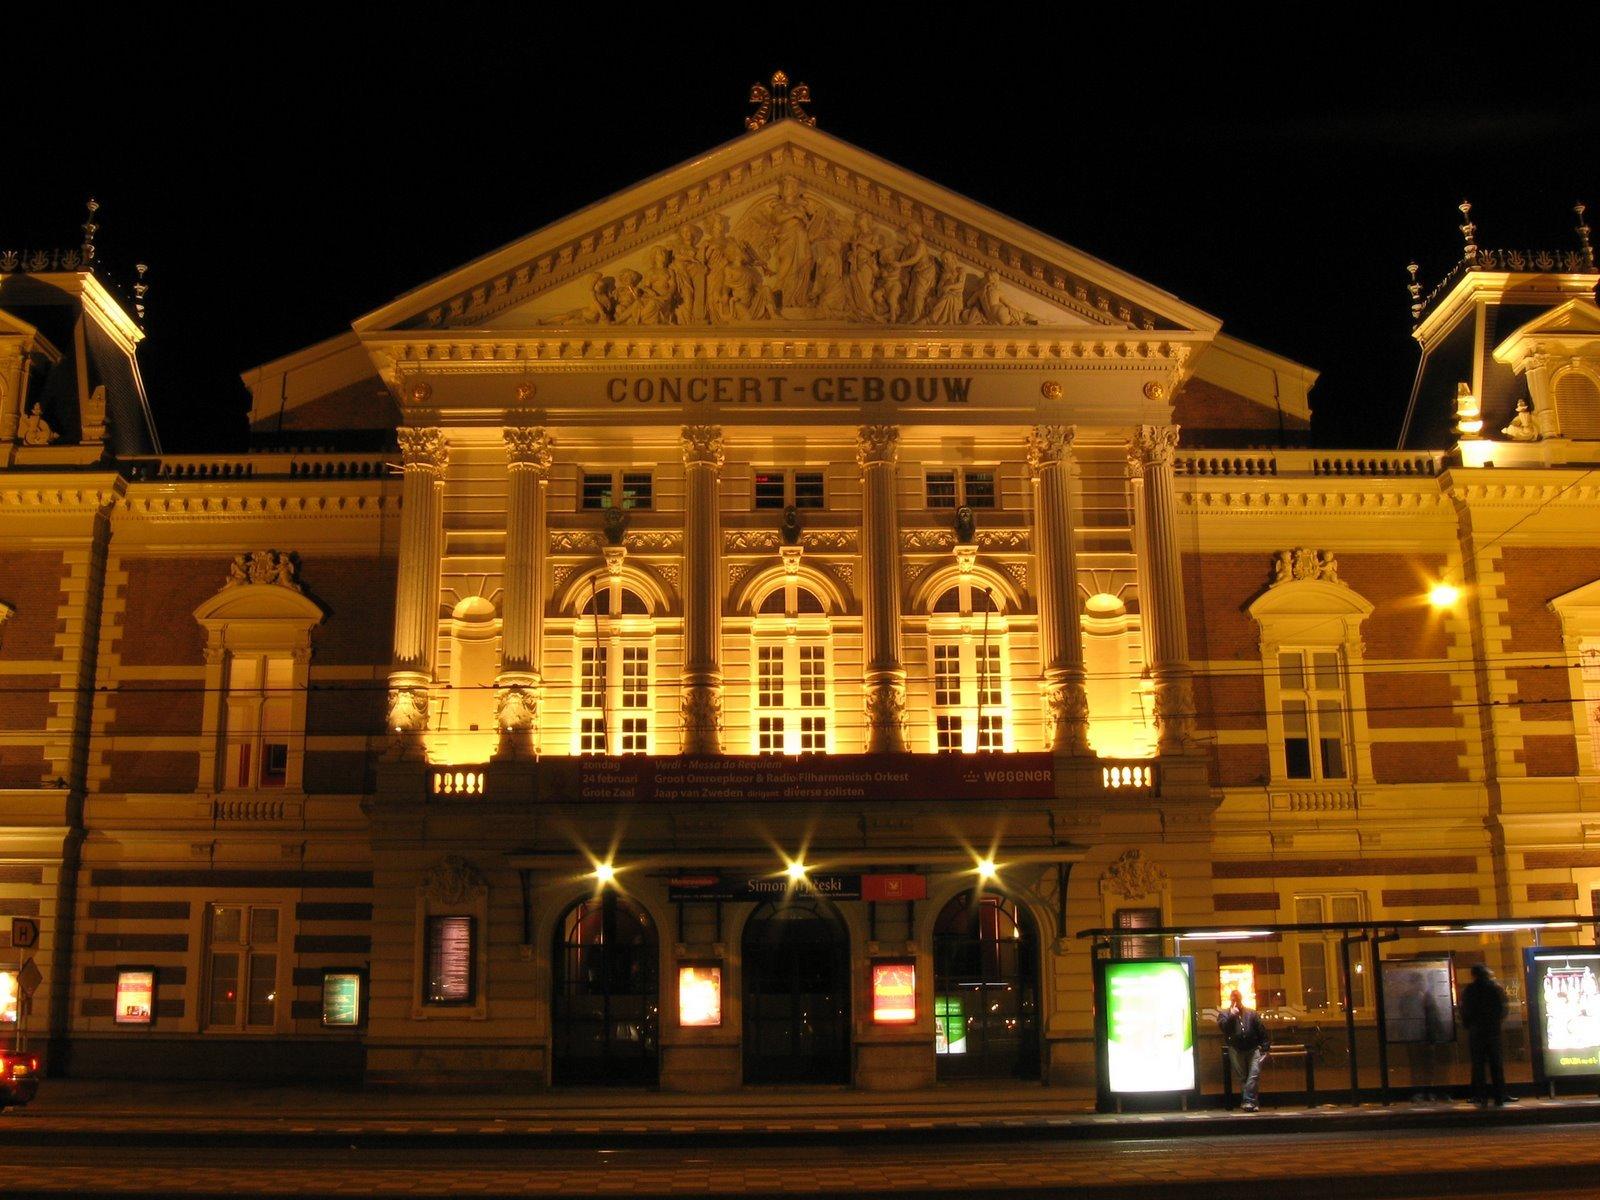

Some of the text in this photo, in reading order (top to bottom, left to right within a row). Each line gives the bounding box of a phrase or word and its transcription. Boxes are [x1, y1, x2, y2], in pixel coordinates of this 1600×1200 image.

[582, 760, 621, 771] zondag
[654, 760, 681, 769] Verdi
[689, 760, 721, 769] Messa
[737, 760, 782, 771] Requiem
[582, 773, 638, 783] 24 februari
[654, 772, 909, 785] Groot Omroepkoor & Radio Filharmonisch Orkest
[582, 787, 635, 797] Grote Zaal
[653, 788, 678, 799] Jaap
[681, 790, 699, 798] van
[701, 788, 743, 798] Zweden
[784, 787, 821, 797] diverse
[823, 787, 864, 797] solisten
[748, 879, 786, 892] Simon
